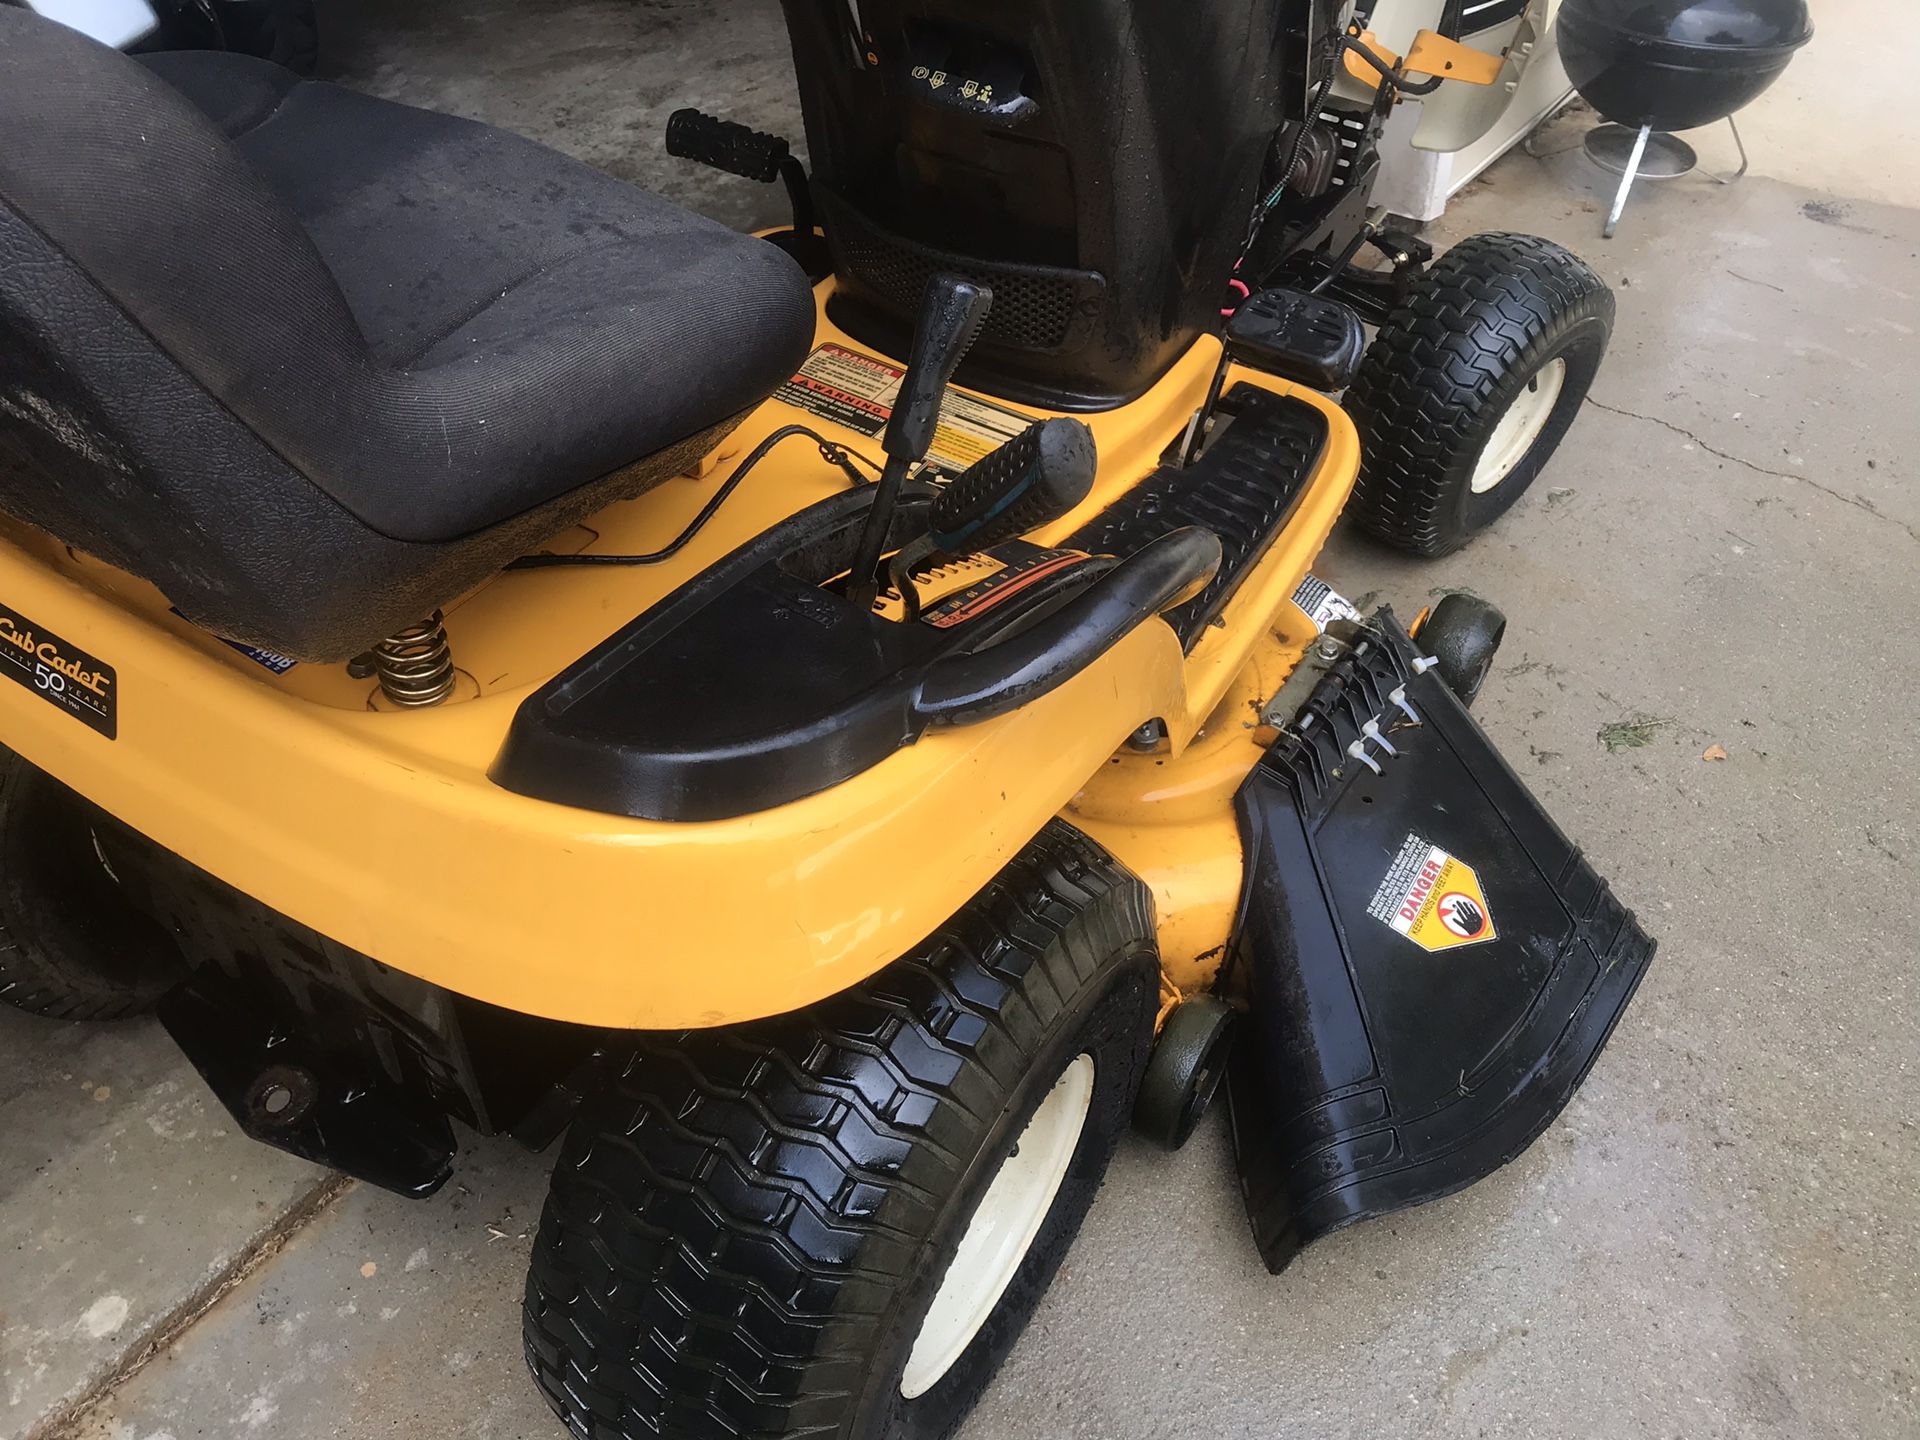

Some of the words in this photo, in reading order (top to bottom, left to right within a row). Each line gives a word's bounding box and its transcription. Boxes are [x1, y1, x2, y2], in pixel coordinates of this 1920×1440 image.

[839, 352, 895, 376] DANGER
[791, 383, 809, 394] AVOID
[809, 389, 834, 404] SERIOUS
[833, 399, 856, 412] INJURY
[865, 412, 885, 423] DEATH
[810, 383, 882, 415] WARNING
[0, 617, 36, 654] Cub
[36, 642, 110, 697] Cadet
[0, 644, 32, 667] IFTY
[34, 662, 66, 690] 50
[68, 684, 108, 712] YEARS
[50, 690, 68, 704] SINCE
[1402, 840, 1410, 849] DO
[1405, 832, 1415, 842] NOT
[1393, 847, 1407, 864] INJURY,
[1404, 852, 1418, 870] PROPER
[1370, 895, 1387, 917] OPERATE
[1382, 878, 1397, 896] UNLESS
[1392, 855, 1410, 879] DISCHARGE
[1405, 842, 1417, 856] COVER
[1412, 835, 1420, 843] OR
[1383, 869, 1394, 881] RISK
[1389, 863, 1397, 871] OF
[1400, 868, 1409, 877] ITS
[1440, 859, 1456, 878] AWAY
[1379, 879, 1388, 890] THE
[1398, 871, 1415, 894] REPLACE
[1399, 859, 1442, 922] DANGER
[1434, 875, 1448, 890] FEET
[1369, 888, 1383, 907] REDUCE
[1384, 885, 1400, 907] CATCHER
[1429, 888, 1441, 901] and
[1365, 905, 1374, 914] TO
[1376, 905, 1389, 920] GRASS
[1417, 898, 1436, 920] HANDS
[1409, 917, 1425, 936] KEEP
